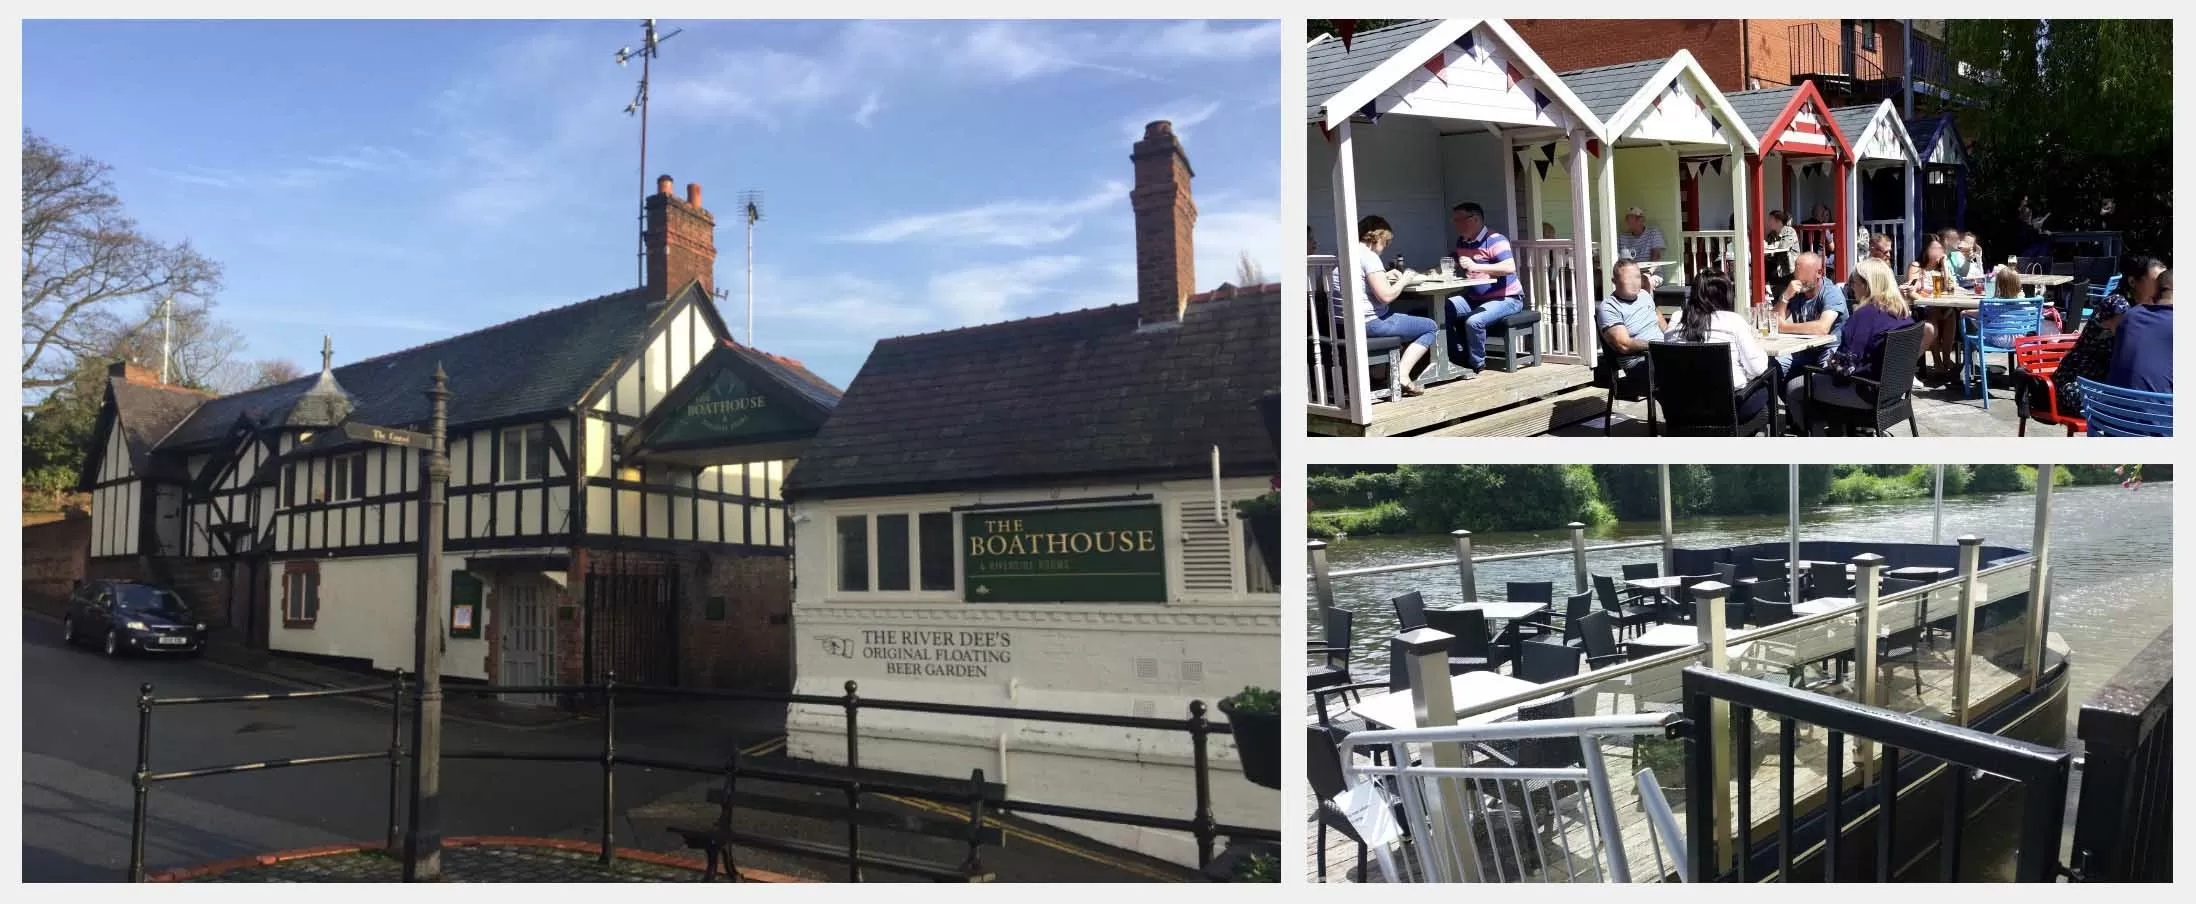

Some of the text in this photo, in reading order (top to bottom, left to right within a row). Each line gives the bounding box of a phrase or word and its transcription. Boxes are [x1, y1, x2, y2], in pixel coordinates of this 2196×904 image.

[687, 395, 767, 417] BOATHOUSE
[984, 519, 1024, 533] THE
[970, 530, 1156, 556] BOATHOUSE
[861, 630, 1011, 648] THE RIVER DEE'S
[862, 646, 1012, 664] ORIGINAL FLOATING
[886, 662, 988, 678] BEER GARDEN
